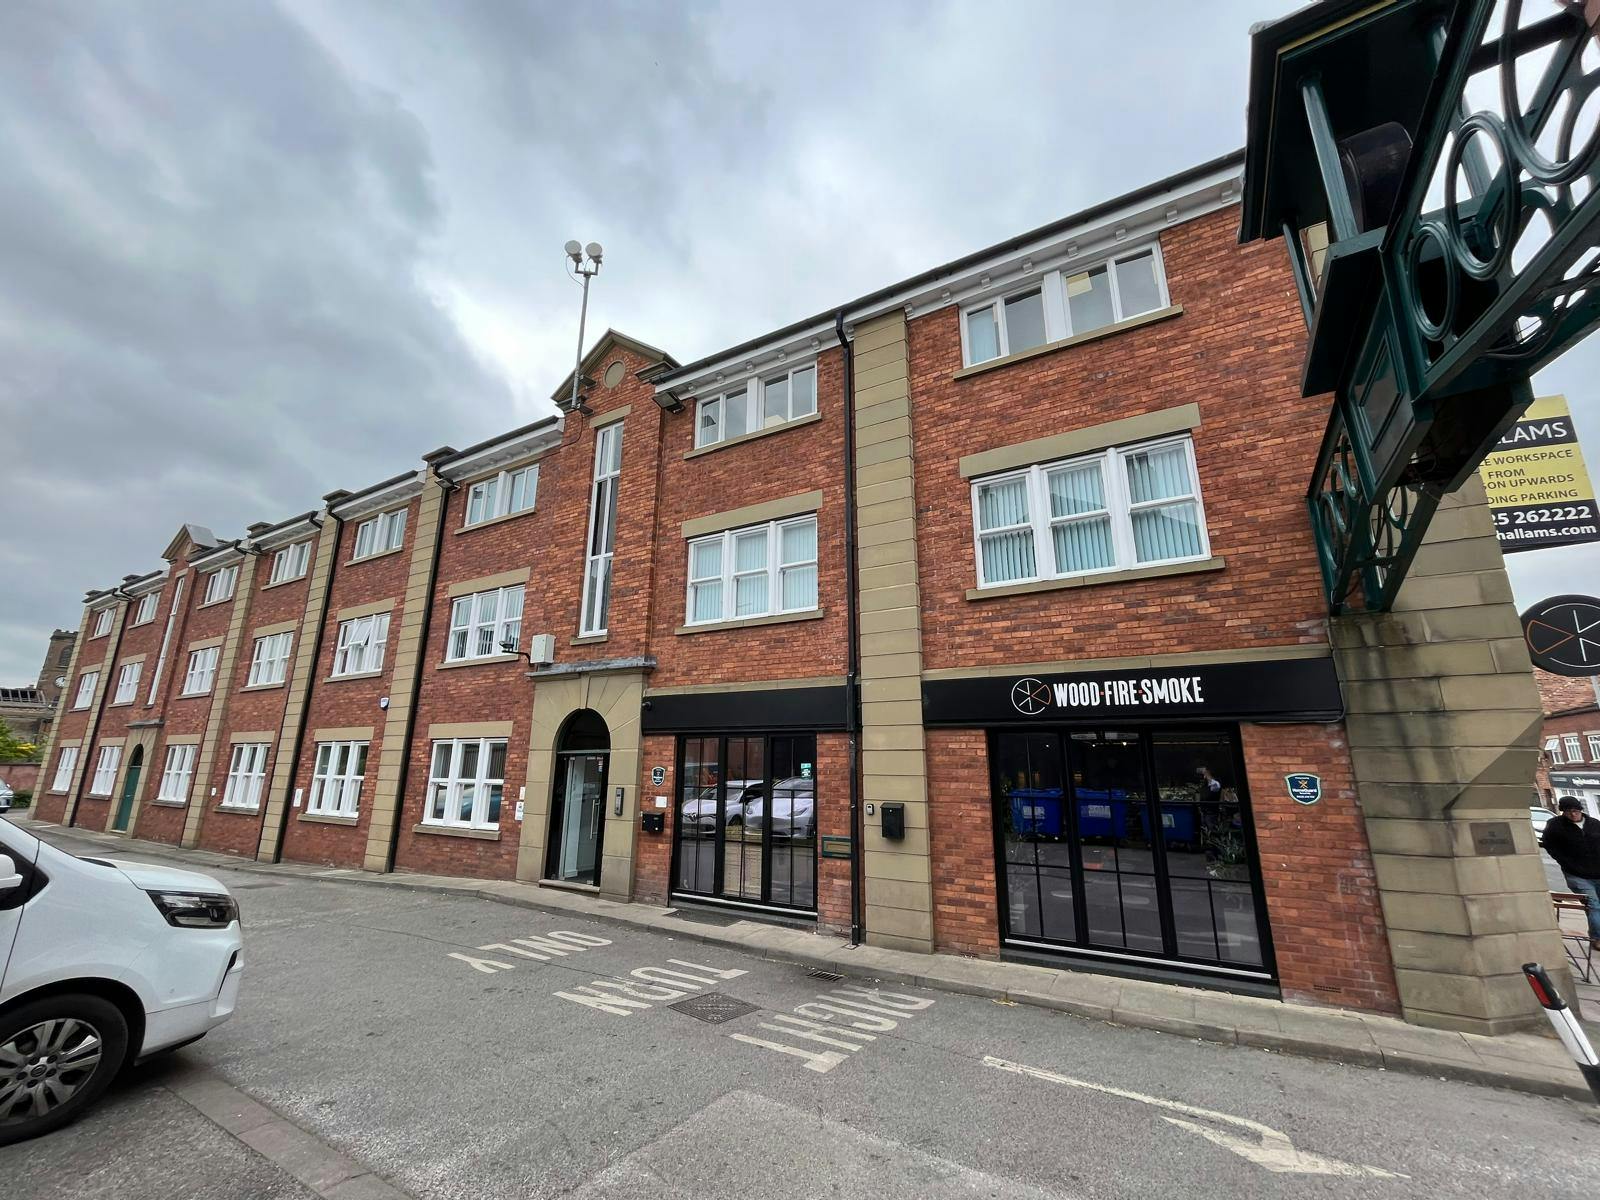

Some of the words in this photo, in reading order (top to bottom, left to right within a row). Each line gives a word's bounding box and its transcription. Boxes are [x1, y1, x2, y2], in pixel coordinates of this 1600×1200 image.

[1498, 422, 1568, 444] LAMS
[1494, 450, 1574, 465] WORKSPACE
[1488, 468, 1525, 479] FROM
[1510, 474, 1575, 488] UPWARDS
[1521, 489, 1578, 502] PARKING
[1513, 506, 1592, 524] 262222
[447, 930, 612, 974] ONLY
[552, 958, 750, 1017] TURN
[729, 985, 935, 1073] RIGHT
